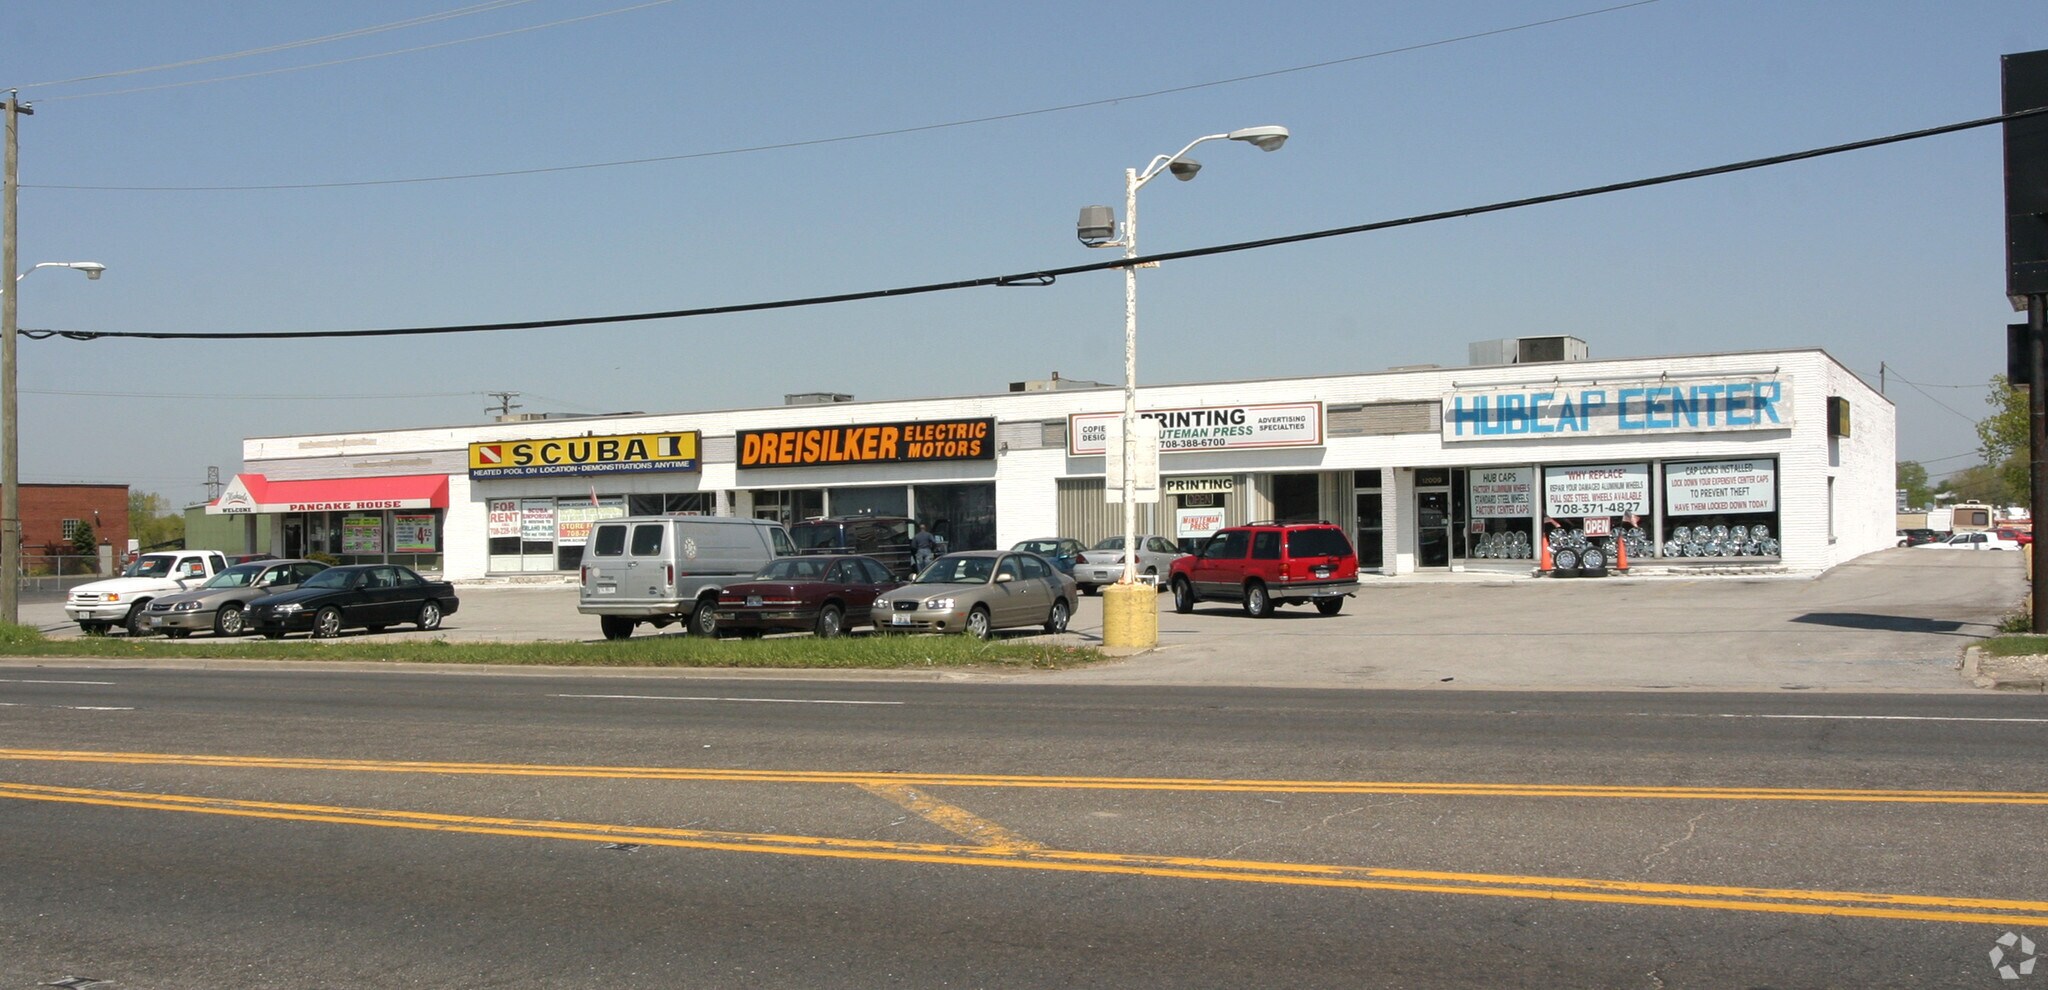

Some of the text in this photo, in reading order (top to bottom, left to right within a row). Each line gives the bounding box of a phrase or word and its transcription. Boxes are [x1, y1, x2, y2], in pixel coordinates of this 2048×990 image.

[1455, 381, 1781, 436] HUBCAP CENTER
[1140, 408, 1246, 428] RINTING
[1258, 415, 1306, 424] ADVERTISING
[904, 422, 987, 442] ELECTRIC
[1082, 425, 1105, 433] COPIE
[1212, 426, 1253, 437] PRESS
[1259, 423, 1305, 431] SPECIALTIES
[1082, 433, 1105, 442] DESIG
[742, 427, 899, 465] DREISILKER
[908, 440, 981, 458] MOTORS
[1159, 438, 1226, 449] 708-388-6700
[512, 439, 649, 466] SCUBA
[474, 469, 501, 477] HEATED
[540, 465, 578, 474] LOCATION
[582, 463, 653, 471] DEMONSTRATIONS
[655, 461, 689, 469] ANYTIME
[1685, 463, 1753, 475] CAP LOCKS INSTALLED
[1483, 472, 1517, 483] HUB CAPS
[1684, 479, 1697, 487] DOWN
[1699, 478, 1711, 486] YOUR
[1712, 476, 1736, 485] EXPENSIVE
[1738, 476, 1755, 484] CENTER
[1756, 475, 1768, 484] CAPS
[1167, 479, 1232, 491] PRINTING
[1473, 485, 1490, 493] FACTORY
[1513, 484, 1530, 492] WHEELS
[1550, 481, 1643, 492] REPAIR YOUR DAMAGED ALUMINUM WHEELS
[1550, 491, 1642, 503] FULL SIZE STEEL WHEELS AVAILABLE
[1690, 487, 1750, 498] TO PREVENT THEFT
[1188, 494, 1211, 505] OPEN
[1474, 494, 1529, 504] STANDARD STEEL WHEELS
[290, 501, 401, 511] PANCAKE HOUSE
[493, 502, 516, 512] FOR
[1476, 504, 1529, 515] FACTORY CENTER CAPS
[1555, 502, 1640, 514] 708-371-4827
[1674, 500, 1768, 511] HAVE THEM LOCKED DOWN TODAY
[490, 512, 519, 523] RENT
[1183, 515, 1219, 524] MINUTEMAN
[1585, 519, 1609, 534] OPEN
